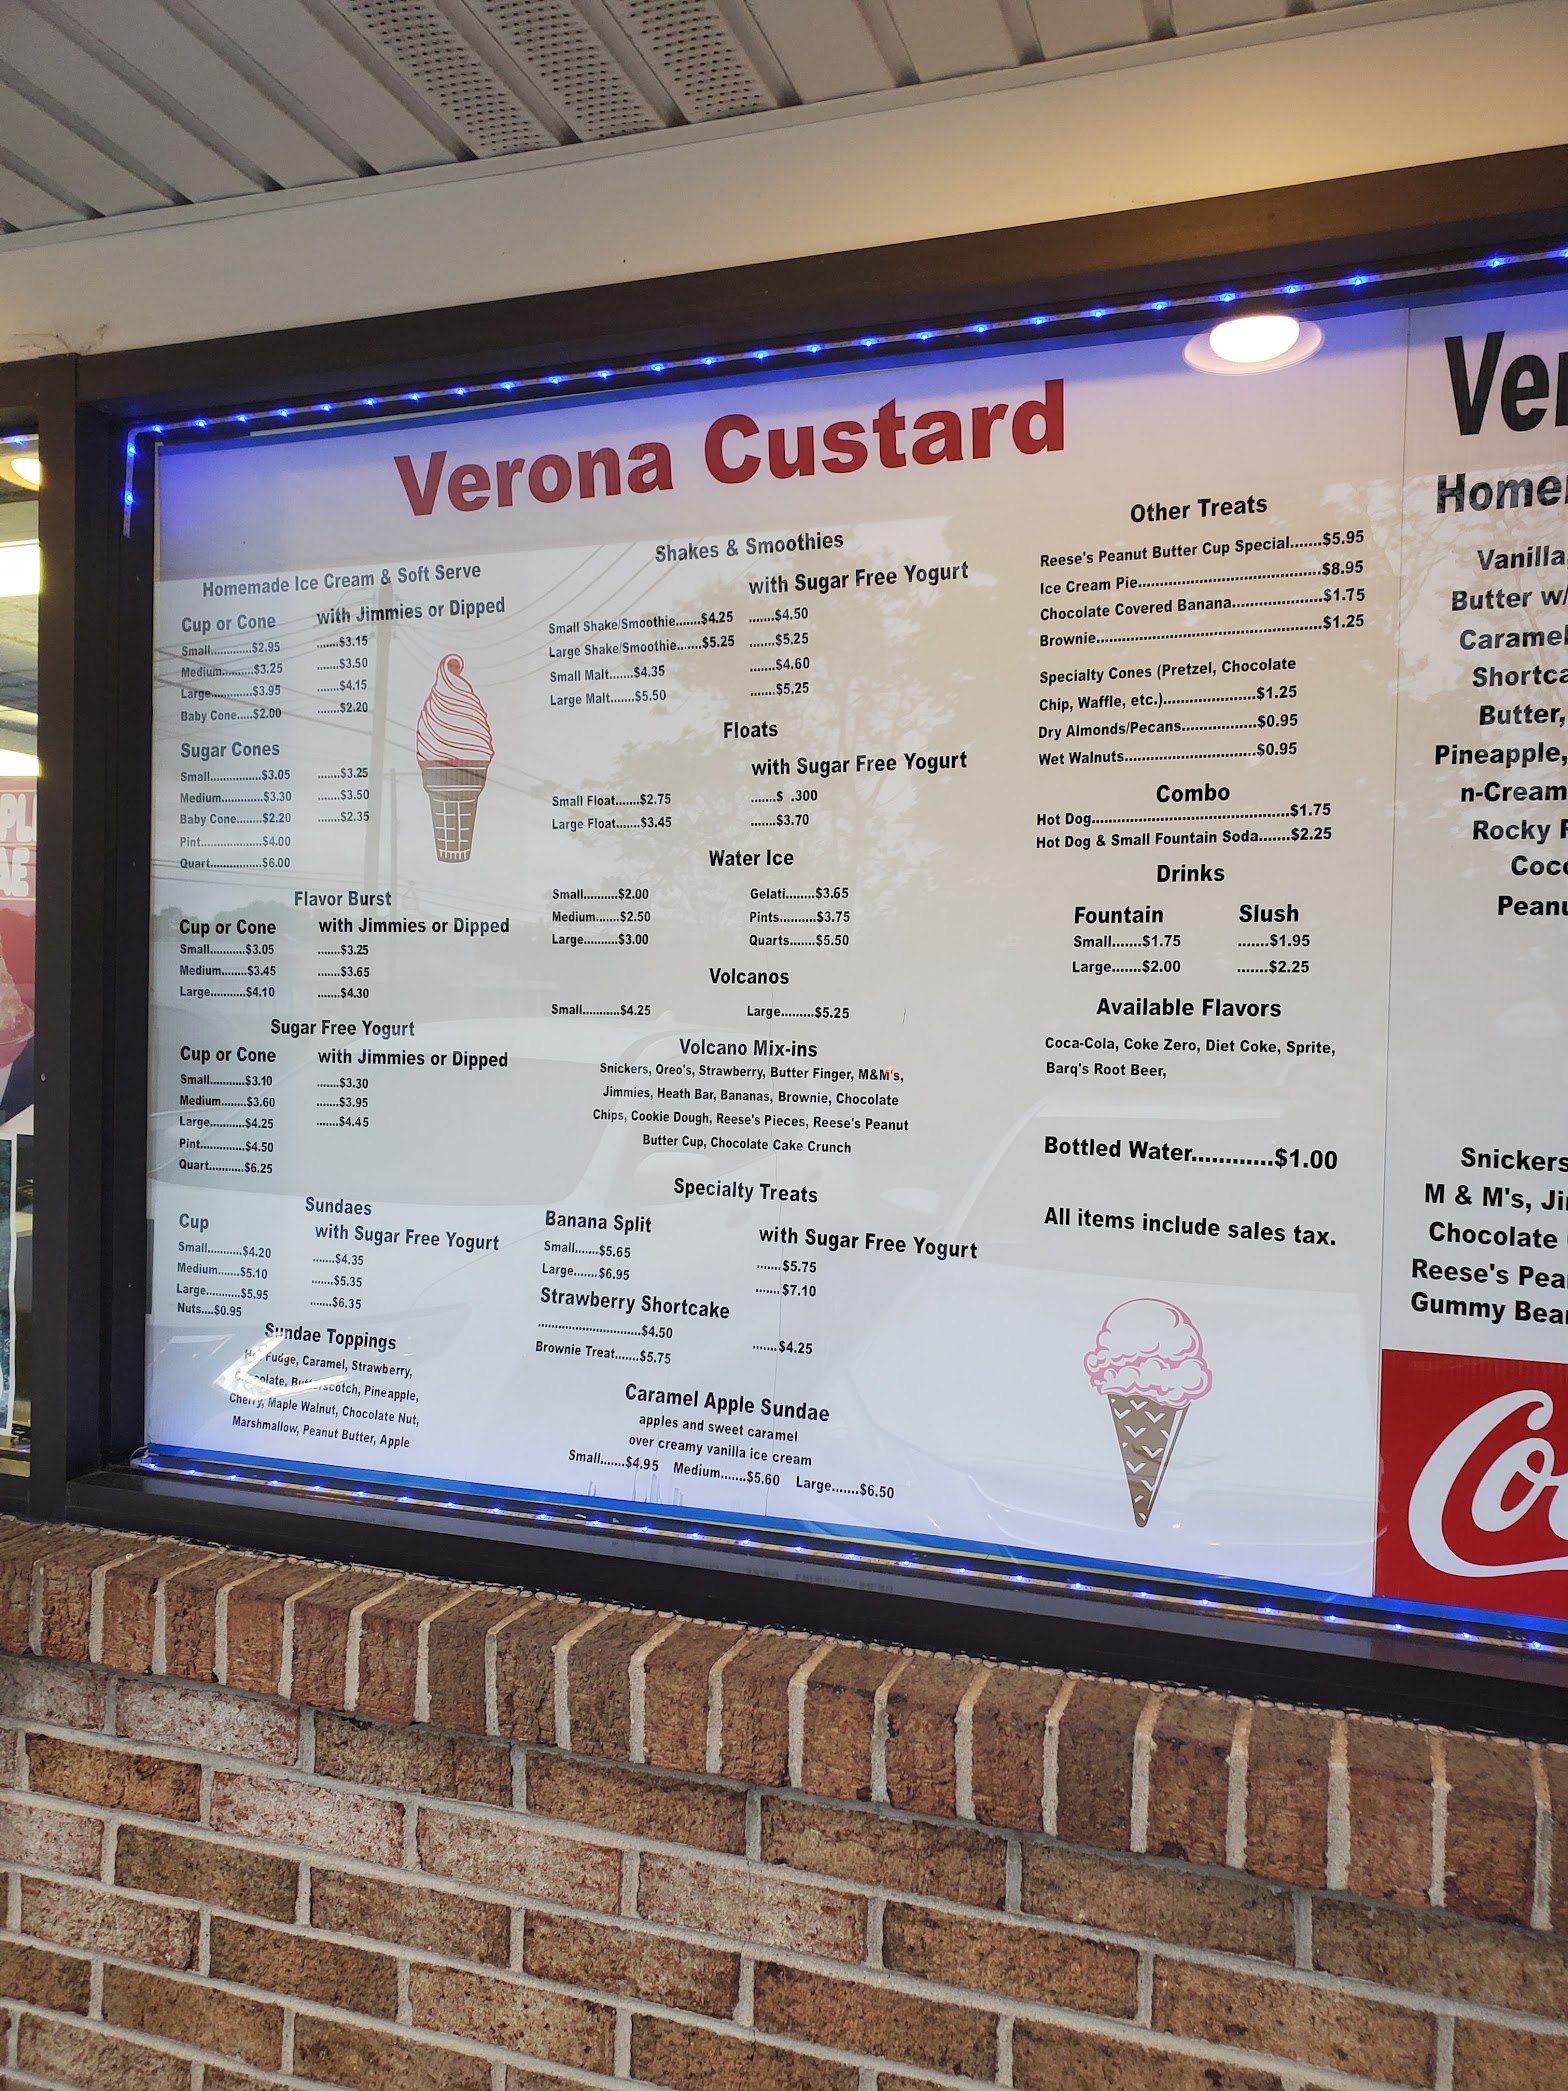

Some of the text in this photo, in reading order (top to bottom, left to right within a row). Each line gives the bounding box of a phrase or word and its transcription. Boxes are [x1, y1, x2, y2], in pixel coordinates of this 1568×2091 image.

[1443, 329, 1568, 437] Ve
[392, 377, 1066, 517] Verona Custard
[1435, 472, 1568, 515] Home
[1130, 495, 1268, 523] Other Treats
[655, 531, 844, 563] Shakes & Smoothies
[202, 564, 481, 598] Homemade Ice Cream & Soft Serve
[748, 560, 969, 595] with Sugar Free Yogurt
[316, 595, 505, 625] with Jimmies or Dipped
[1451, 588, 1533, 612] Butter
[181, 614, 276, 636] Cup or Cone
[1039, 657, 1297, 687] Specialty Cones (Pretzel, Chocolate
[1479, 703, 1566, 728] Butter,
[723, 720, 779, 739] Floats
[180, 741, 280, 762] Sugar Cones
[1156, 782, 1231, 803] Combo
[1472, 819, 1552, 845] Rocky
[708, 848, 794, 867] Water Ice
[1156, 863, 1225, 883] Drinks
[294, 890, 392, 907] Flavor Burst
[1074, 905, 1164, 924] Fountain
[1238, 903, 1299, 923] Slush
[179, 918, 277, 939] Cup or Cone
[318, 917, 510, 937] with Jimmies or Dipped
[709, 967, 790, 985] Volcanos
[1095, 997, 1282, 1018] Available Flavors
[270, 1018, 415, 1040] Sugar Free Yogurt
[679, 1038, 818, 1058] Volcano Mix-ins
[1045, 1036, 1336, 1057] Coca-Cola, Coke Zero, Diet Coke, Sprite,
[599, 1062, 904, 1084] Snickers, Oreo's, Strawberry, Butter Finger, M&M's,
[1046, 1061, 1167, 1080] Barq's Root Beer,
[602, 1085, 899, 1107] Jimmies, Heath Bar, Bananas, Brownie, Chocolate
[592, 1108, 909, 1131] Chips, Cookie Dough, Reese's Pieces, Reese's Peanut
[642, 1133, 852, 1154] Butter Cup, Chocolate Cake Crunch
[1044, 1135, 1121, 1158] Bottled
[673, 1177, 818, 1203] Specialty Treats
[1424, 1182, 1532, 1214] M & M's,
[305, 1196, 372, 1216] Sundaes
[178, 1212, 209, 1233] Cup
[545, 1209, 652, 1236] Banana Split
[1043, 1206, 1336, 1246] All items include sales tax.
[314, 1224, 500, 1253] with Sugar Free Yogurt
[758, 1226, 978, 1261] with Sugar Free Yogurt
[1428, 1221, 1558, 1250] Chocolate
[1411, 1257, 1509, 1285] Reese's
[540, 1286, 730, 1319] Strawberry Shortcake
[1410, 1291, 1507, 1325] Gummy
[264, 1322, 397, 1353] Sundae Toppings
[625, 1383, 830, 1422] Caramel Apple Sundae
[232, 1415, 410, 1450] Marshmallow, Peanut Butter, Apple
[639, 1415, 798, 1443] apples and sweet caramel
[628, 1436, 812, 1466] over creamy vanilla ice cream
